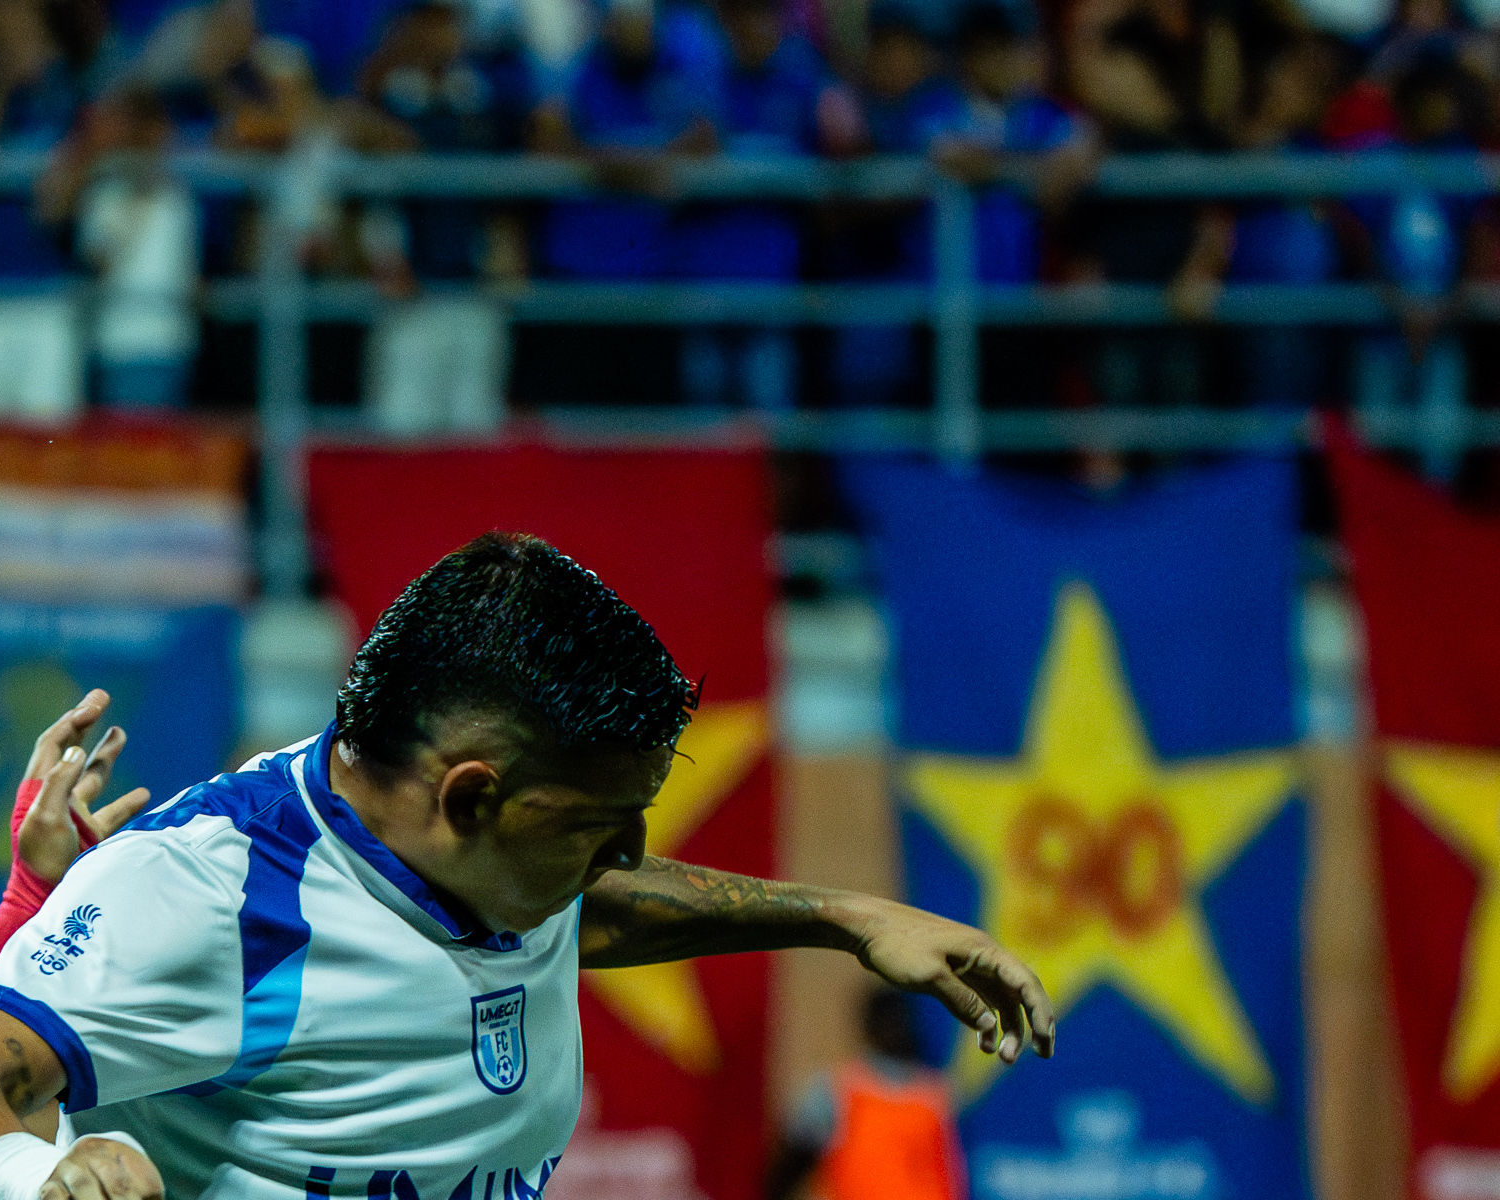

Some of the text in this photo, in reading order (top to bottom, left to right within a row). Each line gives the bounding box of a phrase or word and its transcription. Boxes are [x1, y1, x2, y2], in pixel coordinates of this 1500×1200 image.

[1005, 793, 1188, 948] 90
[44, 934, 85, 958] LPF
[495, 1030, 509, 1054] FC
